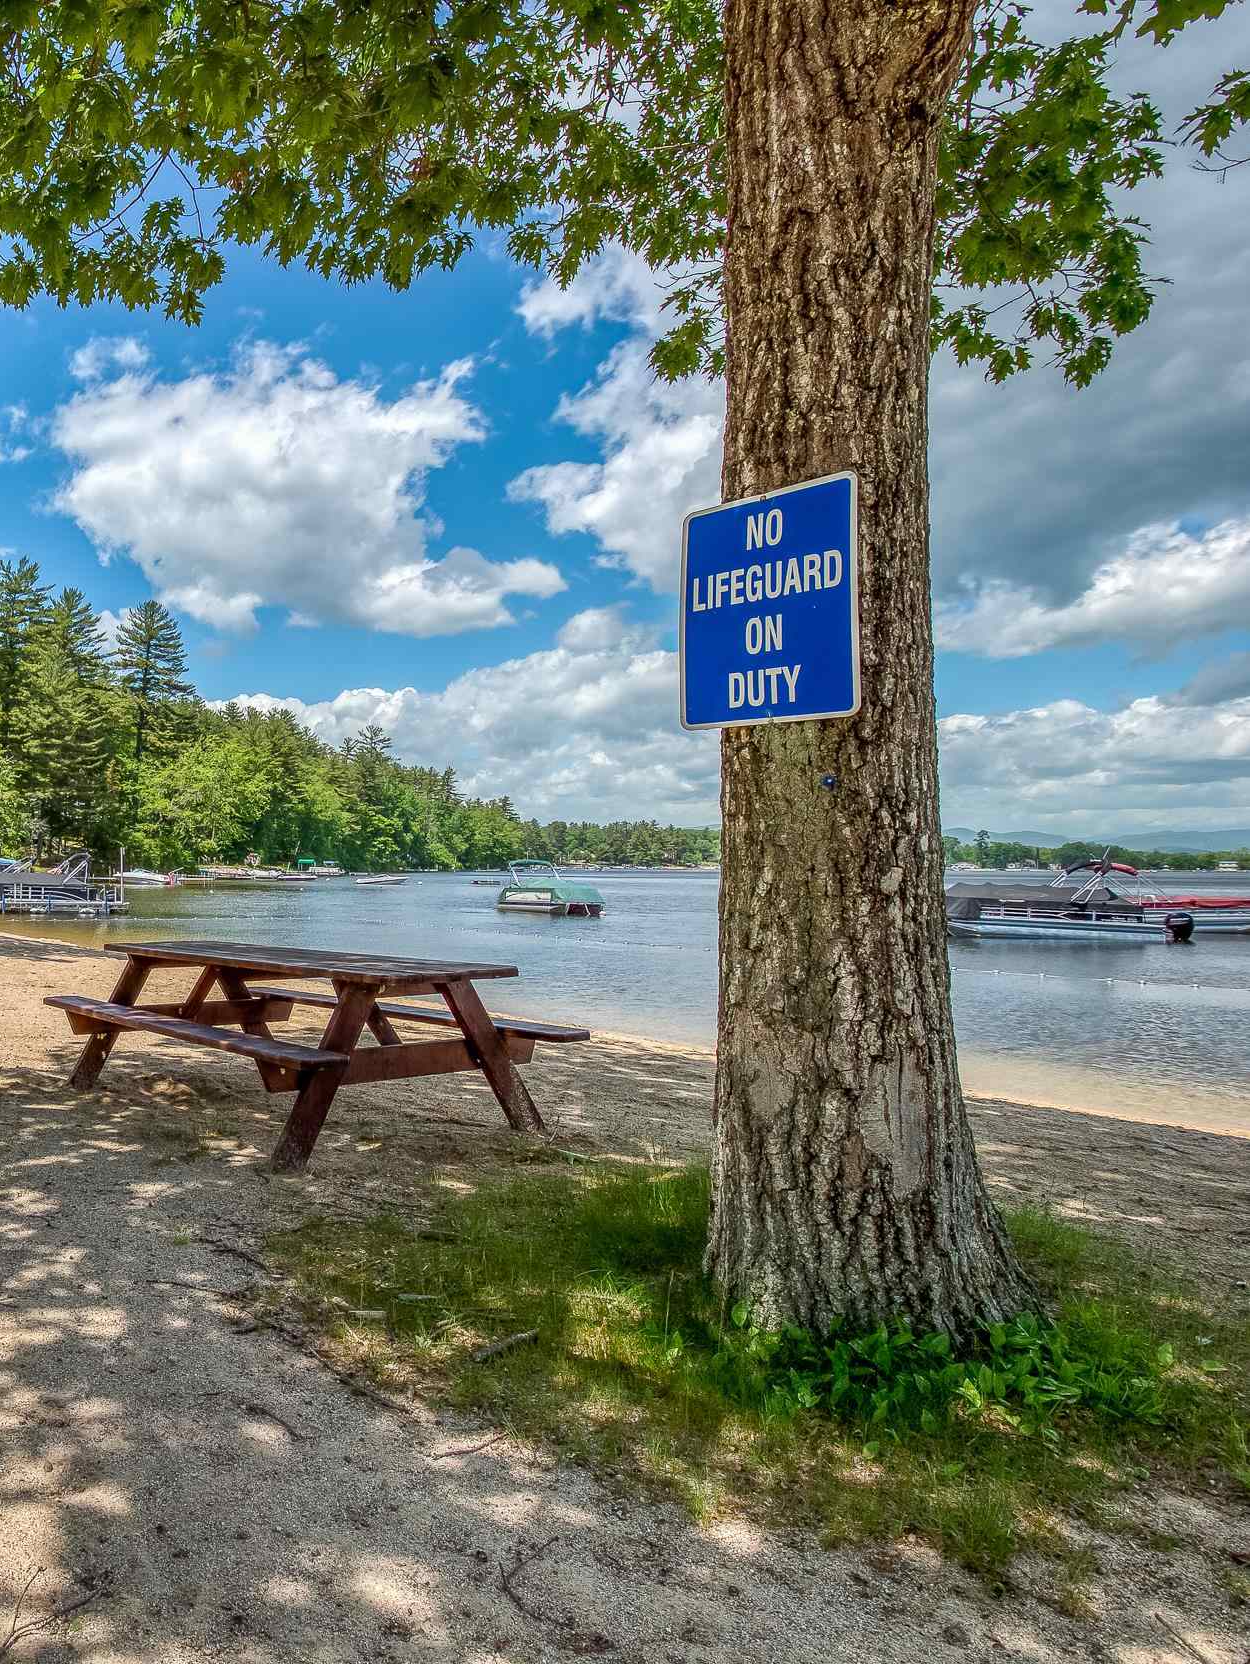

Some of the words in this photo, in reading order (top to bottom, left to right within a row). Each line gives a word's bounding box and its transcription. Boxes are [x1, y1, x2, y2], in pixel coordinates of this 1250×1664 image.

[746, 508, 783, 551] NO
[692, 549, 843, 612] LIFEGUARD
[745, 613, 783, 655] ON
[728, 664, 802, 709] DUTY
